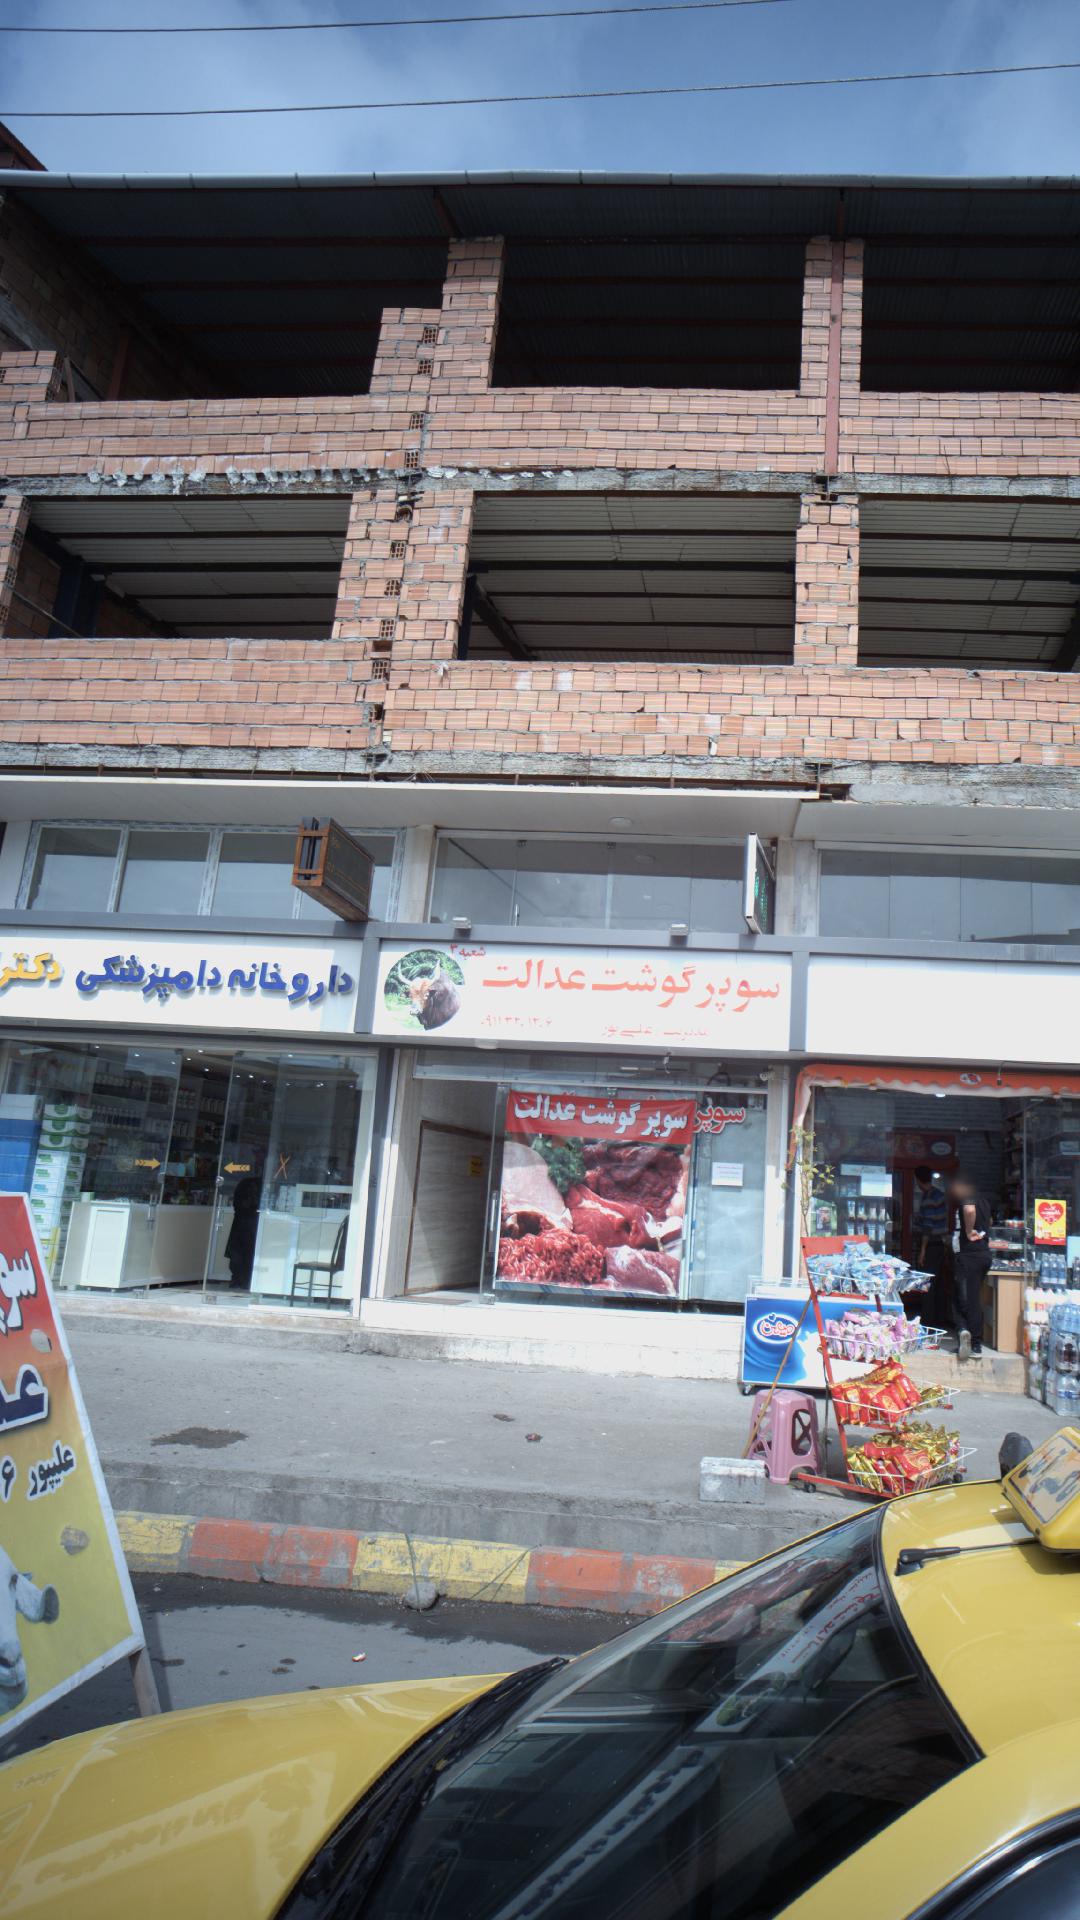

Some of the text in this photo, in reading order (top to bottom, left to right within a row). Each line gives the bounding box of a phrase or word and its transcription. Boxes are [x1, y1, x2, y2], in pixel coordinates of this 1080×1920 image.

[0, 952, 354, 1002] داروخانه دامپزشکی دکتر
[458, 946, 487, 960] شعبه
[482, 958, 781, 1013] سوپر گوشت عدالت
[514, 1094, 687, 1138] سوپر گوشت عدالت
[29, 1443, 76, 1498] علیپور
